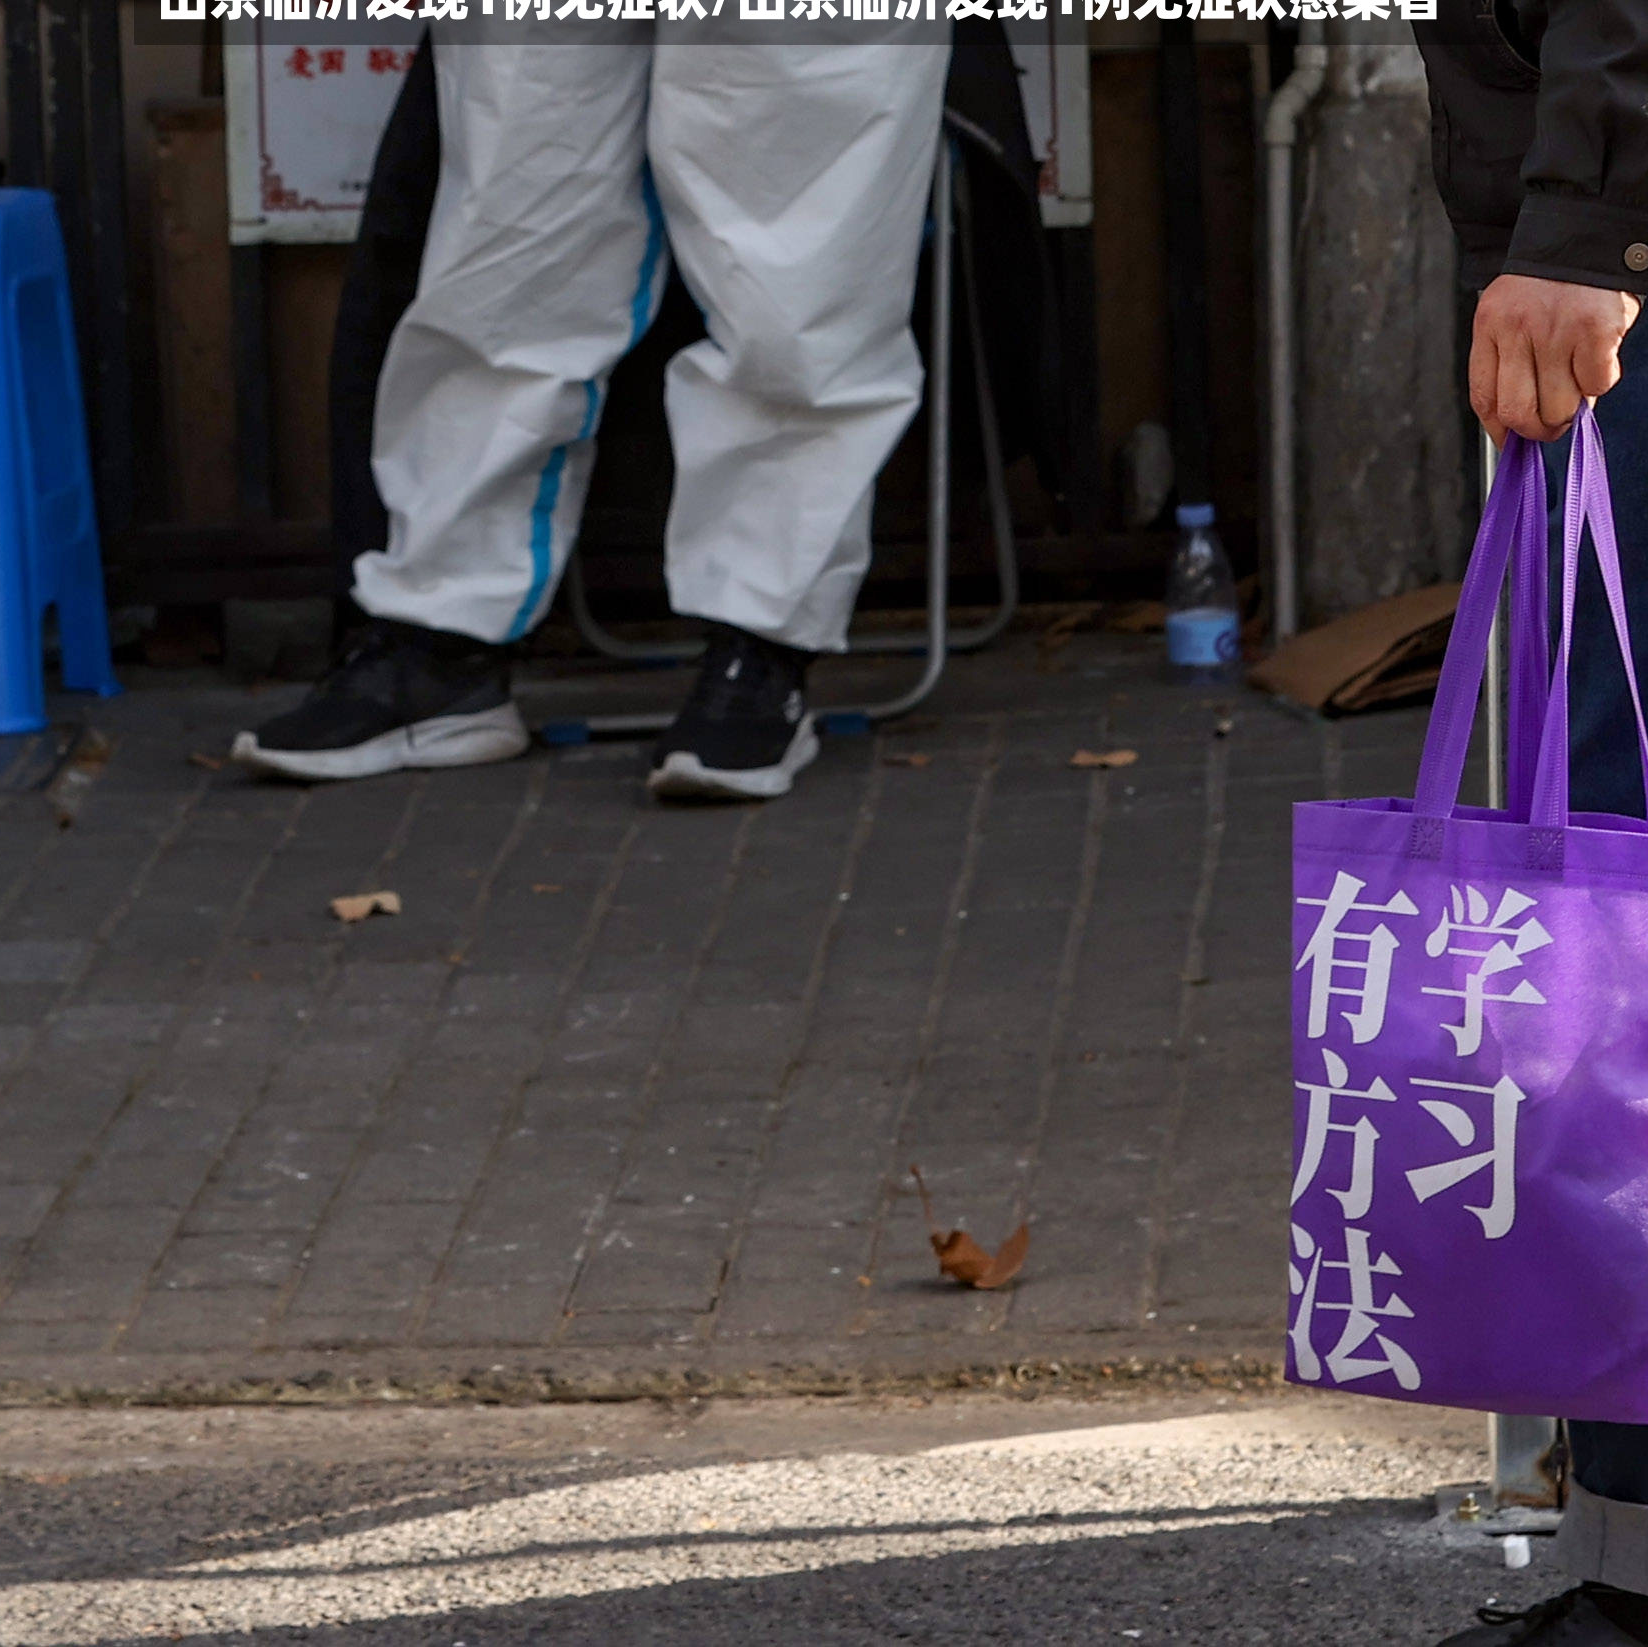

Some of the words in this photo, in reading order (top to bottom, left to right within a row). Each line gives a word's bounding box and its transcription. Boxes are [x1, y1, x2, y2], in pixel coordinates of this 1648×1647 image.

[1288, 869, 1422, 1391] 有方法
[1404, 883, 1554, 1240] 学习
